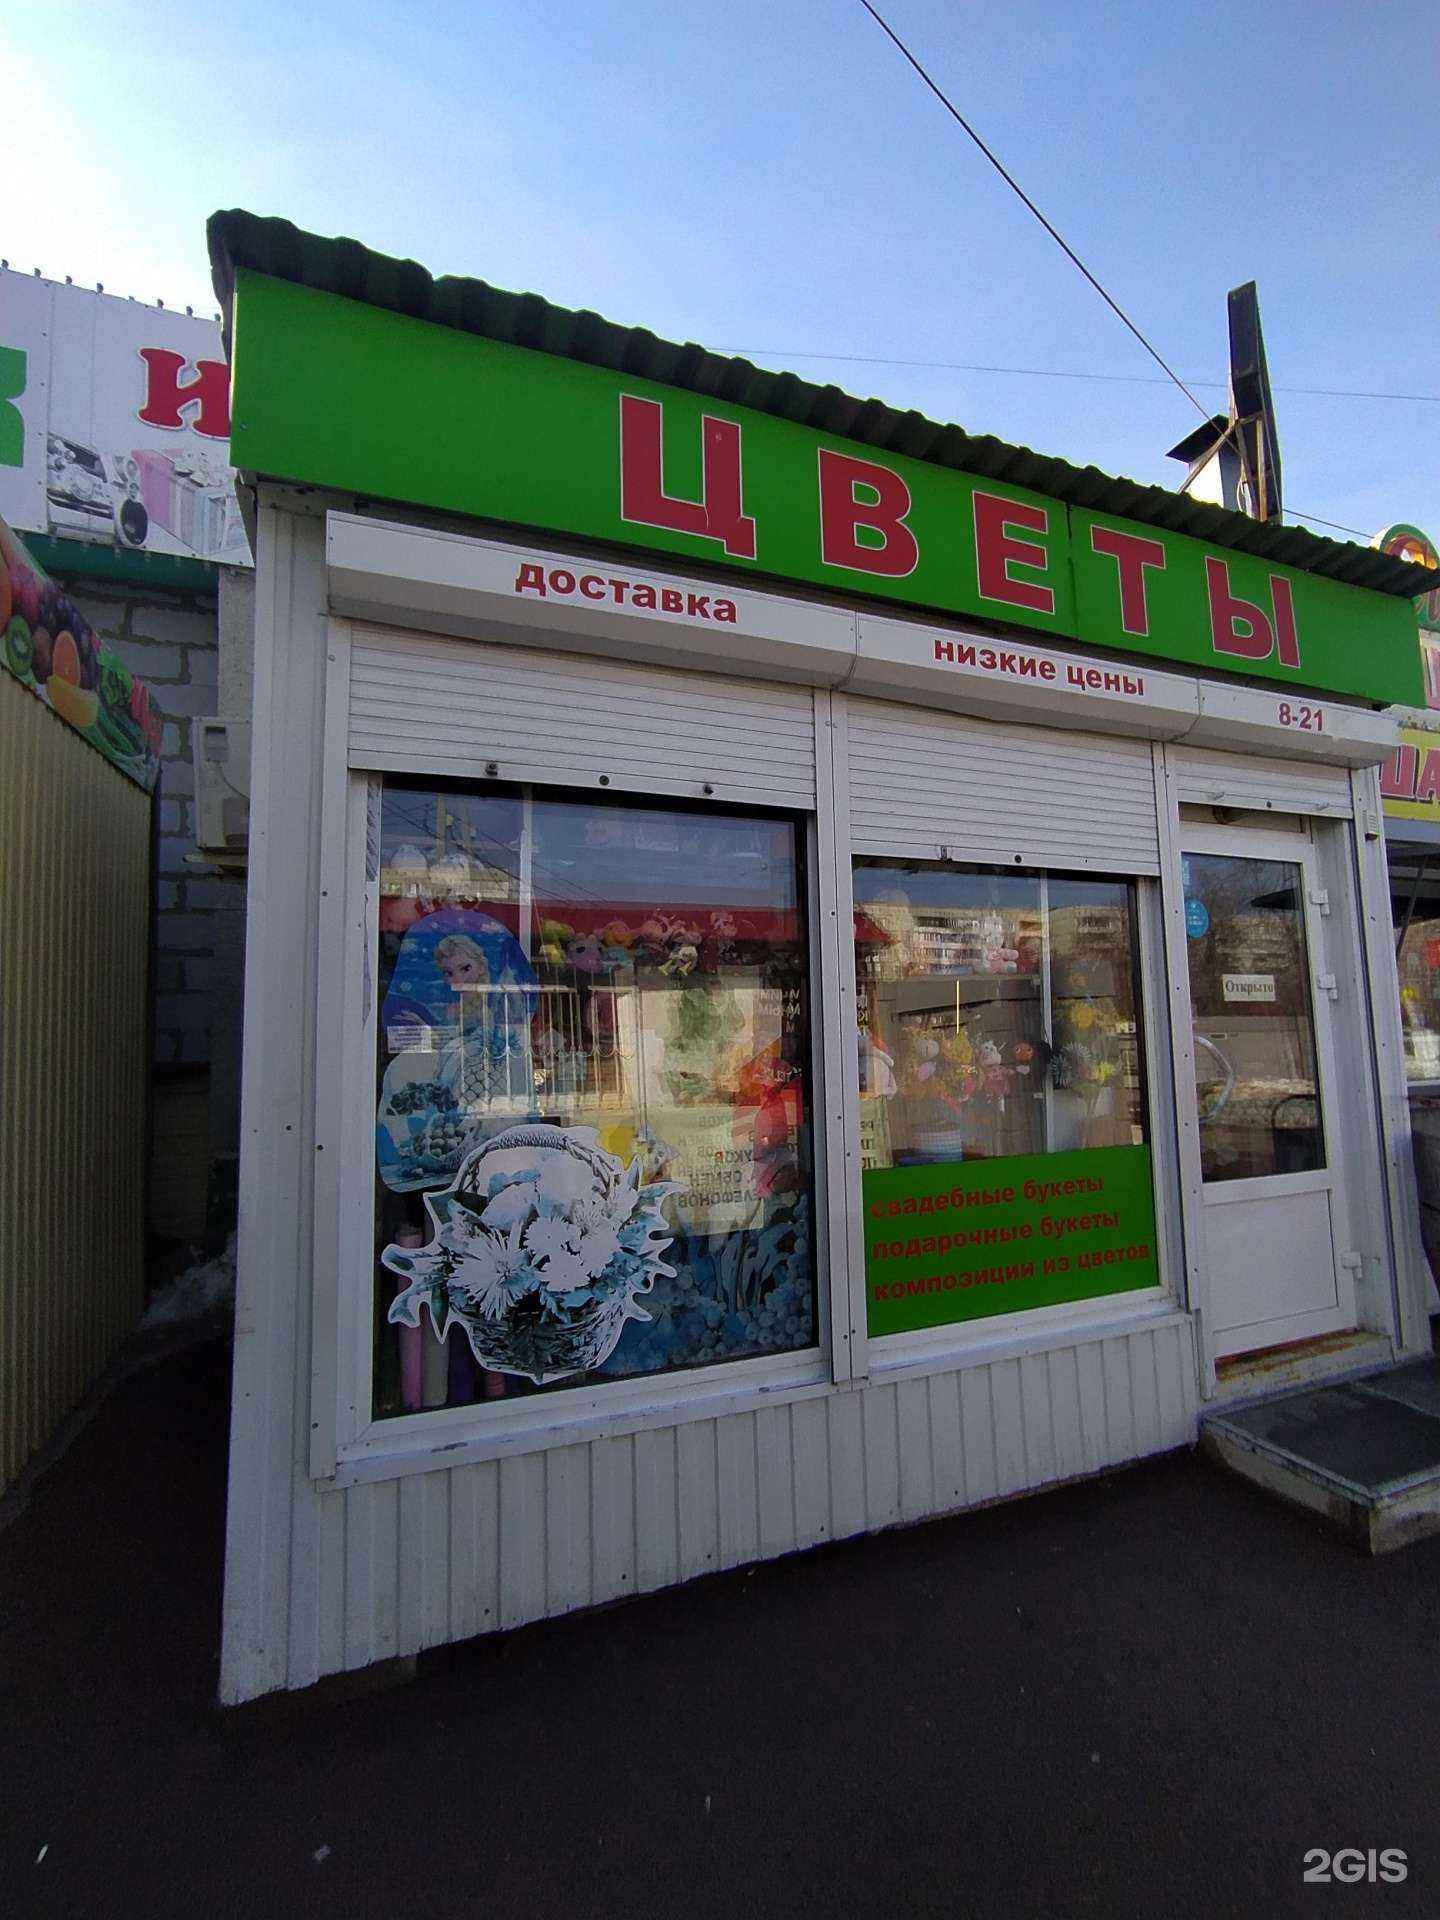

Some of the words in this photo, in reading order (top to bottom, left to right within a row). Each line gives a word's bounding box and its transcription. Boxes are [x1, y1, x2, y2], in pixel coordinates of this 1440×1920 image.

[620, 393, 1301, 669] ЦВЕТЫ
[515, 563, 738, 624] доставка
[934, 640, 1056, 681] низкие
[1067, 665, 1144, 696] цены
[1279, 702, 1322, 731] 8-21
[1226, 980, 1275, 996] Открыто
[869, 1184, 1015, 1219] свадебные
[1023, 1175, 1105, 1201] букеты
[872, 1221, 1033, 1260] подарочные
[1040, 1211, 1120, 1238] букеты
[874, 1259, 1035, 1301] композиции
[1043, 1254, 1070, 1274] из
[1078, 1243, 1149, 1271] цветов
